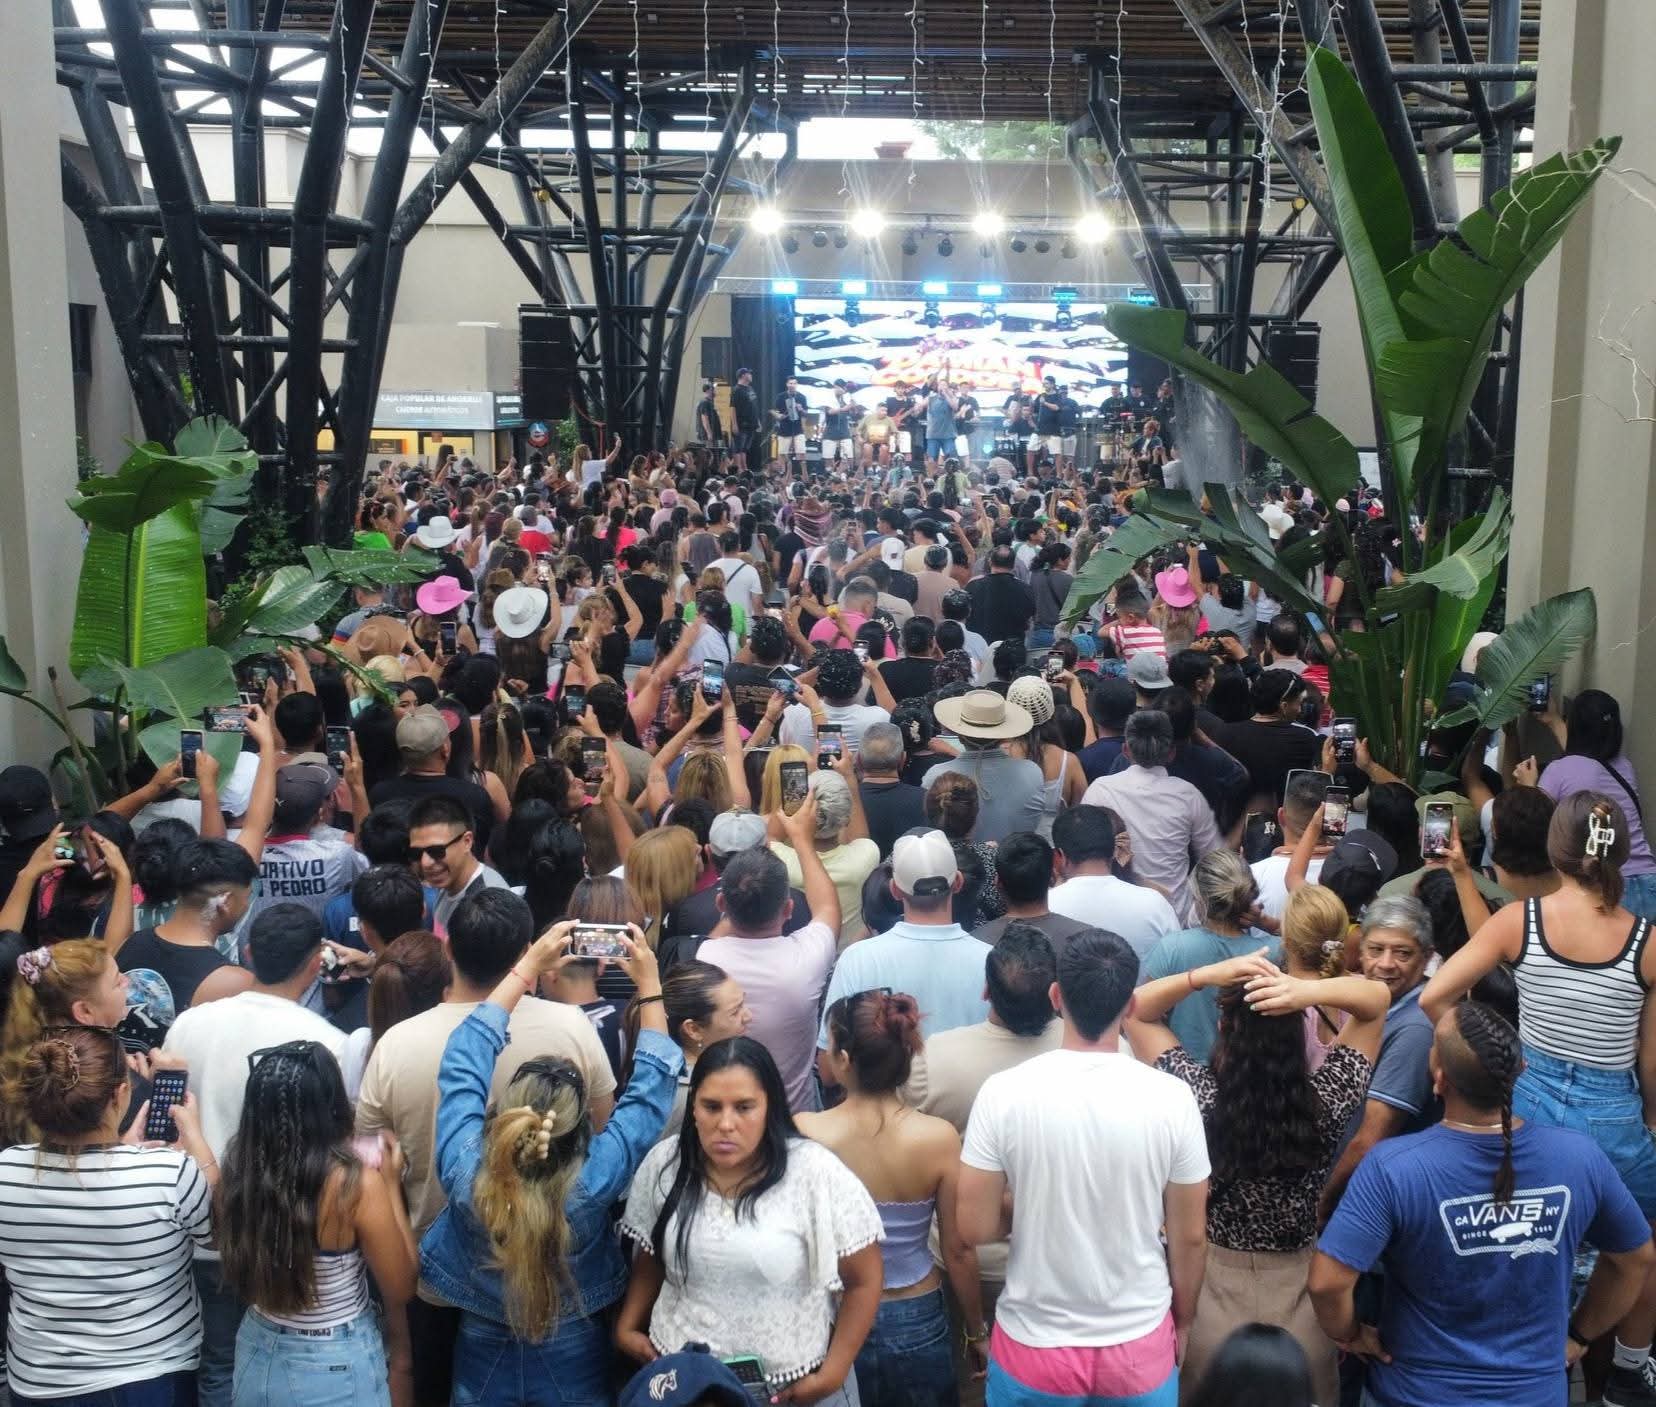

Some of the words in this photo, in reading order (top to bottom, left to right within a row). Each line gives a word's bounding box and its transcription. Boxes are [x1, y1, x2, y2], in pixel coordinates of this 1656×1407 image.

[270, 877, 326, 897] PEDRO
[1469, 1198, 1544, 1226] VANS
[1545, 1206, 1559, 1216] NY
